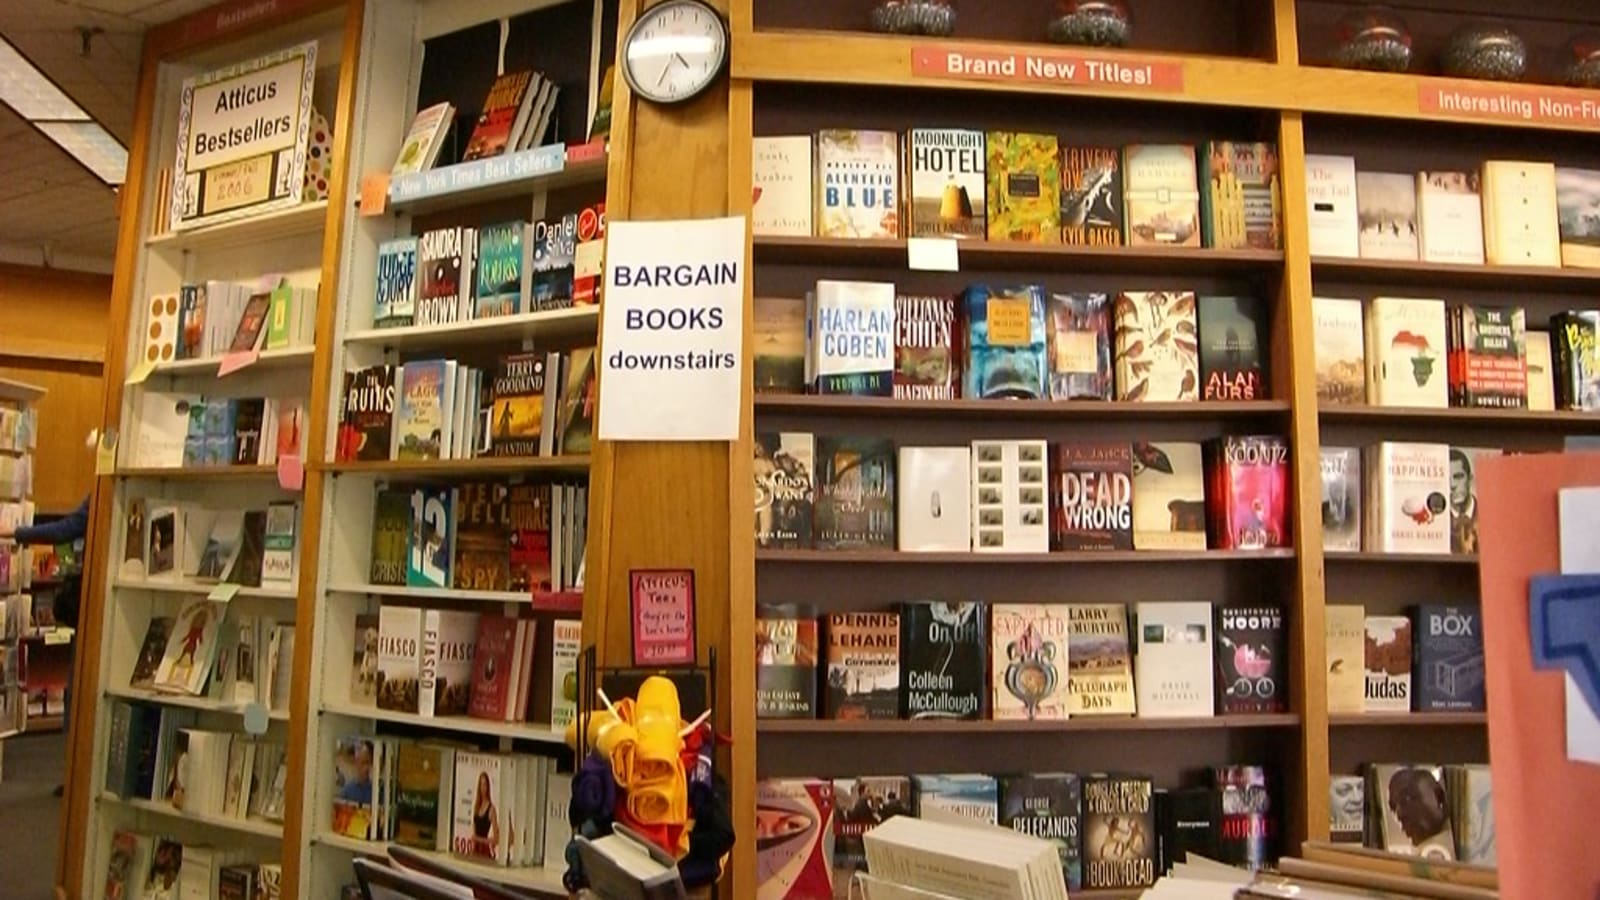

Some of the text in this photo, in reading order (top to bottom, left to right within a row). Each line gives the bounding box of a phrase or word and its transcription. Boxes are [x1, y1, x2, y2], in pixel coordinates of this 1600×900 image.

[658, 17, 667, 28] 11
[947, 53, 1152, 84] Brand New Titles!
[215, 80, 277, 114] Atticus
[1439, 90, 1533, 119] Interesting
[195, 115, 291, 155] Bestsellers
[915, 147, 985, 174] HOTEL
[401, 153, 552, 196] New York Times Best Sellers
[826, 187, 893, 209] BLUE
[535, 214, 578, 243] Daniel
[422, 229, 462, 262] SANDRA
[546, 239, 575, 259] Silva
[614, 262, 737, 287] BARGAIN
[419, 295, 460, 326] BROWN
[626, 307, 723, 330] BOOKS
[820, 307, 890, 334] HARLAN
[1487, 311, 1501, 322] THE
[825, 333, 887, 359] COBEN
[895, 320, 951, 349] COHEN
[507, 360, 533, 378] TERRY
[609, 349, 735, 371] downstairs
[1209, 371, 1259, 387] ALAN
[348, 386, 395, 413] RUINS
[1224, 440, 1288, 465] KOONTZ
[1388, 465, 1446, 478] HAPPINESS
[1062, 472, 1131, 508] DEAD
[1064, 504, 1131, 530] WRONG
[410, 488, 447, 588] 12
[462, 565, 500, 590] SPY
[832, 615, 898, 628] DENNIS
[1068, 606, 1110, 621] LARRY
[1223, 616, 1281, 631] MOORE
[1430, 614, 1473, 636] BOX
[380, 637, 417, 657] FIASCO
[829, 633, 898, 647] LEHANE
[421, 630, 437, 690] FIASCO
[908, 671, 954, 690] Colleen
[908, 691, 979, 714] McCullough
[1081, 694, 1113, 710] DAYS
[1013, 815, 1078, 838] PELECANOS
[1090, 858, 1153, 887] BOOK DEAD
